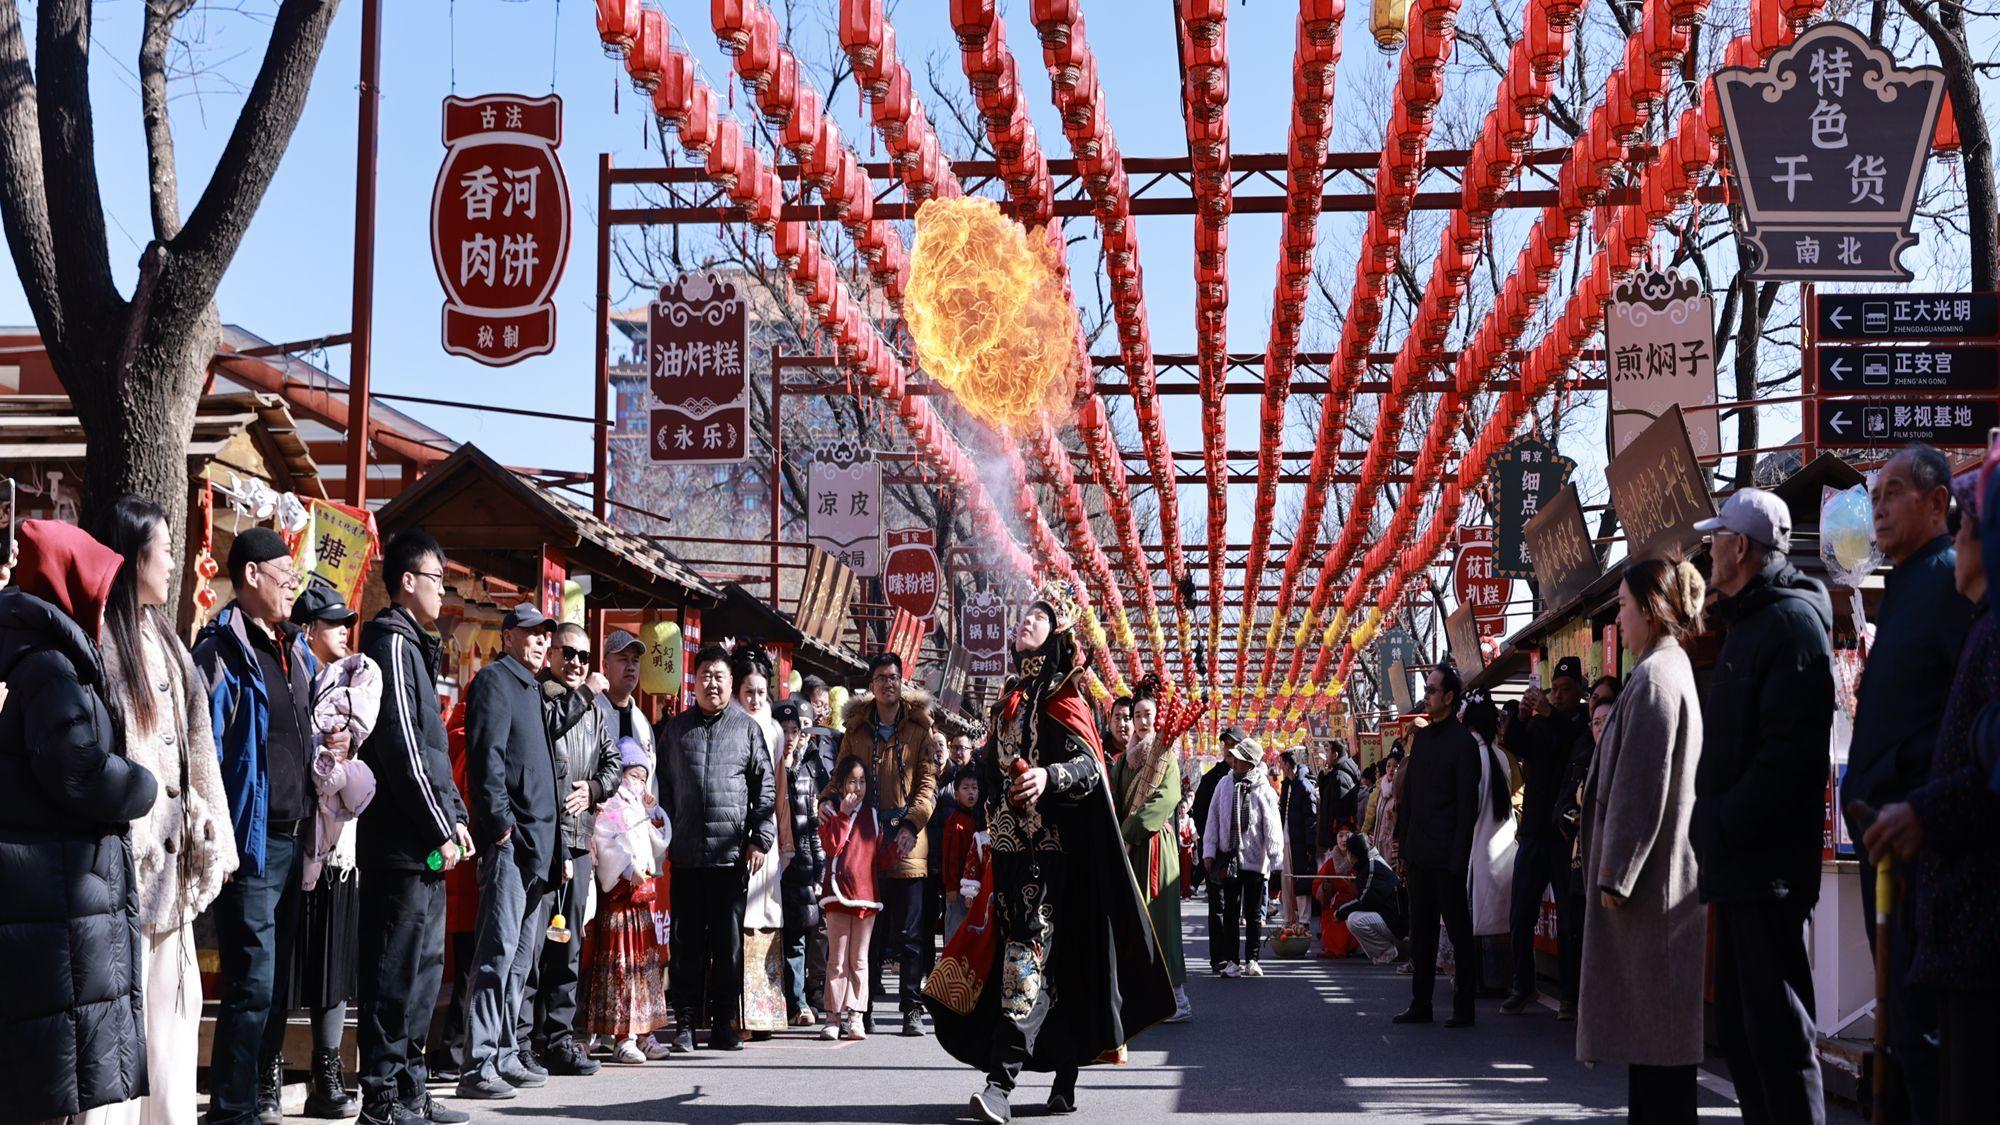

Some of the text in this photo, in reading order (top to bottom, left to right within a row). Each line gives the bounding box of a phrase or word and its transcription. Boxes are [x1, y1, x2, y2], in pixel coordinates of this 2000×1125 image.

[1809, 47, 1852, 149] 特色
[480, 105, 522, 129] 古法
[460, 165, 541, 220] 香河
[1771, 154, 1887, 205] 干货
[460, 233, 539, 288] 肉饼
[1795, 236, 1862, 265] 南北
[1893, 300, 1971, 321] 正大光明
[477, 325, 520, 349] 秘制
[1893, 325, 1964, 333] ZHENGDAGUANGMING
[655, 340, 741, 378] 油炸糕
[1615, 340, 1710, 381] 煎焖子
[1894, 352, 1952, 374] 正安宫
[1894, 405, 1973, 427] 影视基地
[673, 423, 722, 450] 永乐
[1520, 450, 1543, 463] 两京
[817, 490, 870, 517] 凉皮
[888, 571, 935, 595] 嗦粉档
[969, 623, 1000, 640] 锅贴
[651, 642, 663, 668] 大明
[663, 646, 675, 674] 幻境
